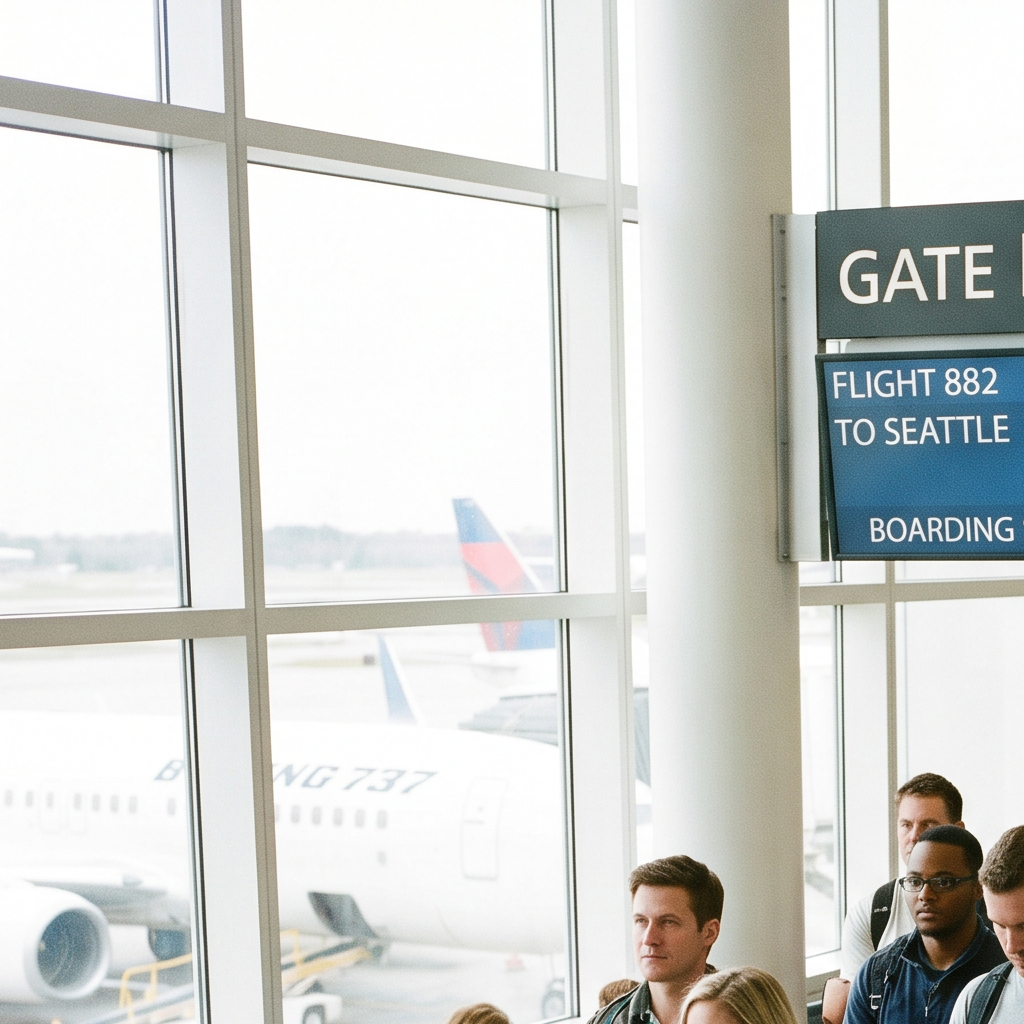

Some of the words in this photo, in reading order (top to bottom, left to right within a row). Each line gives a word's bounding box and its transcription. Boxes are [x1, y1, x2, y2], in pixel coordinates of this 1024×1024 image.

[839, 244, 995, 305] GATE
[832, 368, 935, 399] FLIGHT
[944, 367, 999, 396] 882
[833, 418, 876, 446] TO
[884, 414, 1010, 446] SEATTLE
[869, 516, 1015, 543] BOARDING
[343, 768, 437, 794] 737
